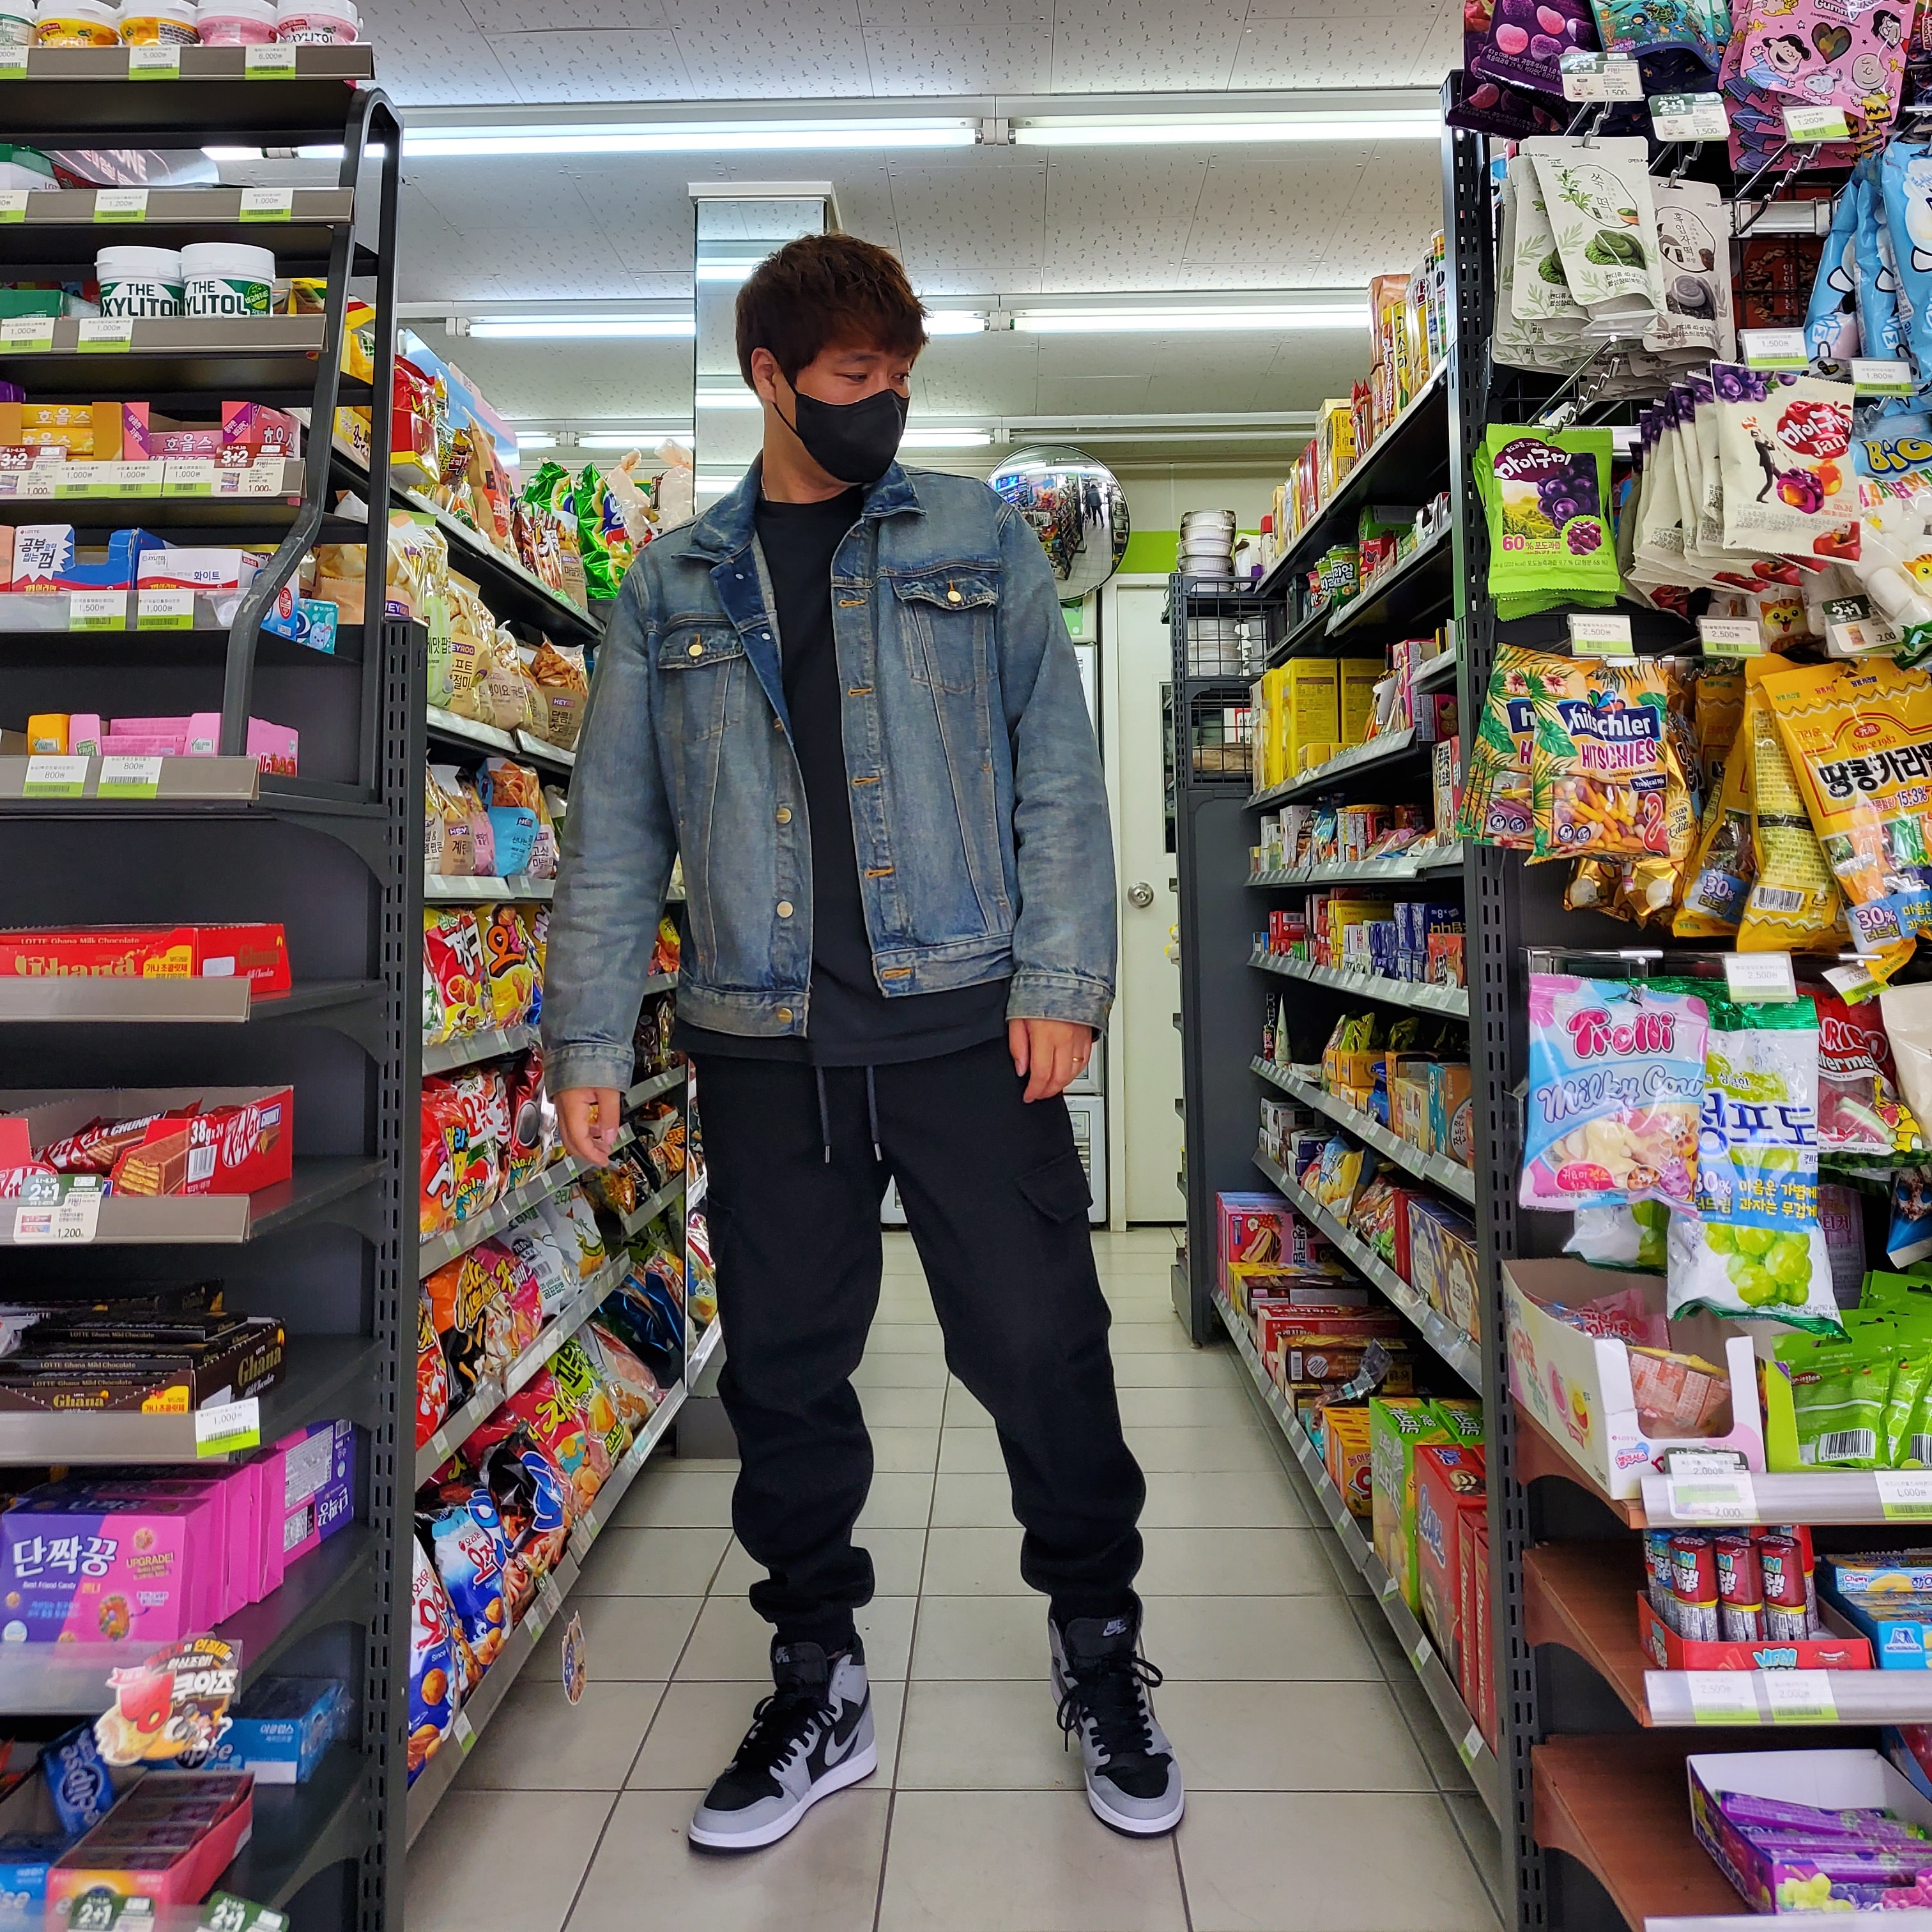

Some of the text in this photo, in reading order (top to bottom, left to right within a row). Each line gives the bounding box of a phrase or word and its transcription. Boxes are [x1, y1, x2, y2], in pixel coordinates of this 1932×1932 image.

[1657, 100, 1686, 114] 2+1
[1797, 116, 1825, 126] 1,200원
[254, 197, 279, 205] 1,000원
[1673, 212, 1695, 257] 흑임자떡
[128, 282, 155, 296] THE
[192, 280, 216, 294] THE
[184, 294, 250, 316] YLITOL
[96, 324, 121, 332] 1,000원
[1396, 315, 1408, 369] 고소미
[1761, 339, 1790, 348] 1,500원
[1866, 372, 1893, 380] 1,800원
[35, 408, 91, 425] 호올스
[22, 432, 72, 448] 호올스
[164, 433, 213, 452] 호올스
[1, 453, 28, 466] 3+2
[221, 450, 249, 464] 3+2
[1494, 448, 1572, 479] 마이구미
[1535, 540, 1561, 551] 포도과즙
[22, 549, 56, 569] 씹는 껌
[194, 570, 220, 581] 화이트
[79, 604, 105, 612] 1,500원
[146, 604, 172, 613] 1,000원
[1831, 602, 1863, 620] 2+1
[1583, 627, 1611, 636] 2,500원
[1712, 630, 1740, 639] 2,500원
[452, 641, 475, 656] EYROO
[454, 660, 473, 670] 프트
[454, 675, 471, 692] 절미
[1850, 675, 1878, 687] 땅콩카라멜
[1569, 707, 1651, 737] hitschler
[1851, 735, 1897, 753] Since 1982
[1581, 737, 1657, 770] HITSCHIES
[1634, 777, 1657, 787] Tropical
[1896, 787, 1928, 806] 15.3%
[1705, 875, 1735, 901] 30%
[1698, 895, 1726, 914] 더드림
[1855, 908, 1897, 930] 30%
[1864, 925, 1900, 944] 더드림
[146, 963, 159, 972] 가나
[1747, 970, 1778, 980] 2,500원
[1567, 1007, 1676, 1059] Trolli
[1537, 1064, 1705, 1124] Milky Cow
[111, 1113, 162, 1137] CHUNKY
[261, 1109, 280, 1126] CHUNKY
[224, 1109, 259, 1165] KitKat
[1561, 1168, 1588, 1181] 귀요미
[28, 1182, 60, 1201] 2+1
[1738, 1178, 1818, 1200] 마음은 가볍게
[1738, 1197, 1818, 1219] 과자는 무겁게
[238, 1345, 282, 1388] Ghana
[53, 1394, 105, 1408] Ghana
[213, 1411, 243, 1425] 1,000원
[1693, 1467, 1724, 1476] 2,000원
[1715, 1507, 1741, 1519] 2,000
[13, 1534, 118, 1578] 단짝꿍
[126, 1552, 174, 1568] UPGRADE!
[1671, 1564, 1700, 1584] PUSH
[1844, 1574, 1869, 1584] Chewy
[38, 1581, 57, 1589] Friend
[58, 1581, 77, 1590] Candy
[1676, 1576, 1699, 1593] POP
[1844, 1581, 1869, 1591] Candy
[1752, 1648, 1798, 1668] MEGA
[1701, 1684, 1732, 1694] 2,500원
[1779, 1689, 1810, 1699] 2,000원
[78, 1903, 113, 1930] 2+1
[210, 1904, 247, 1931] 2+1
